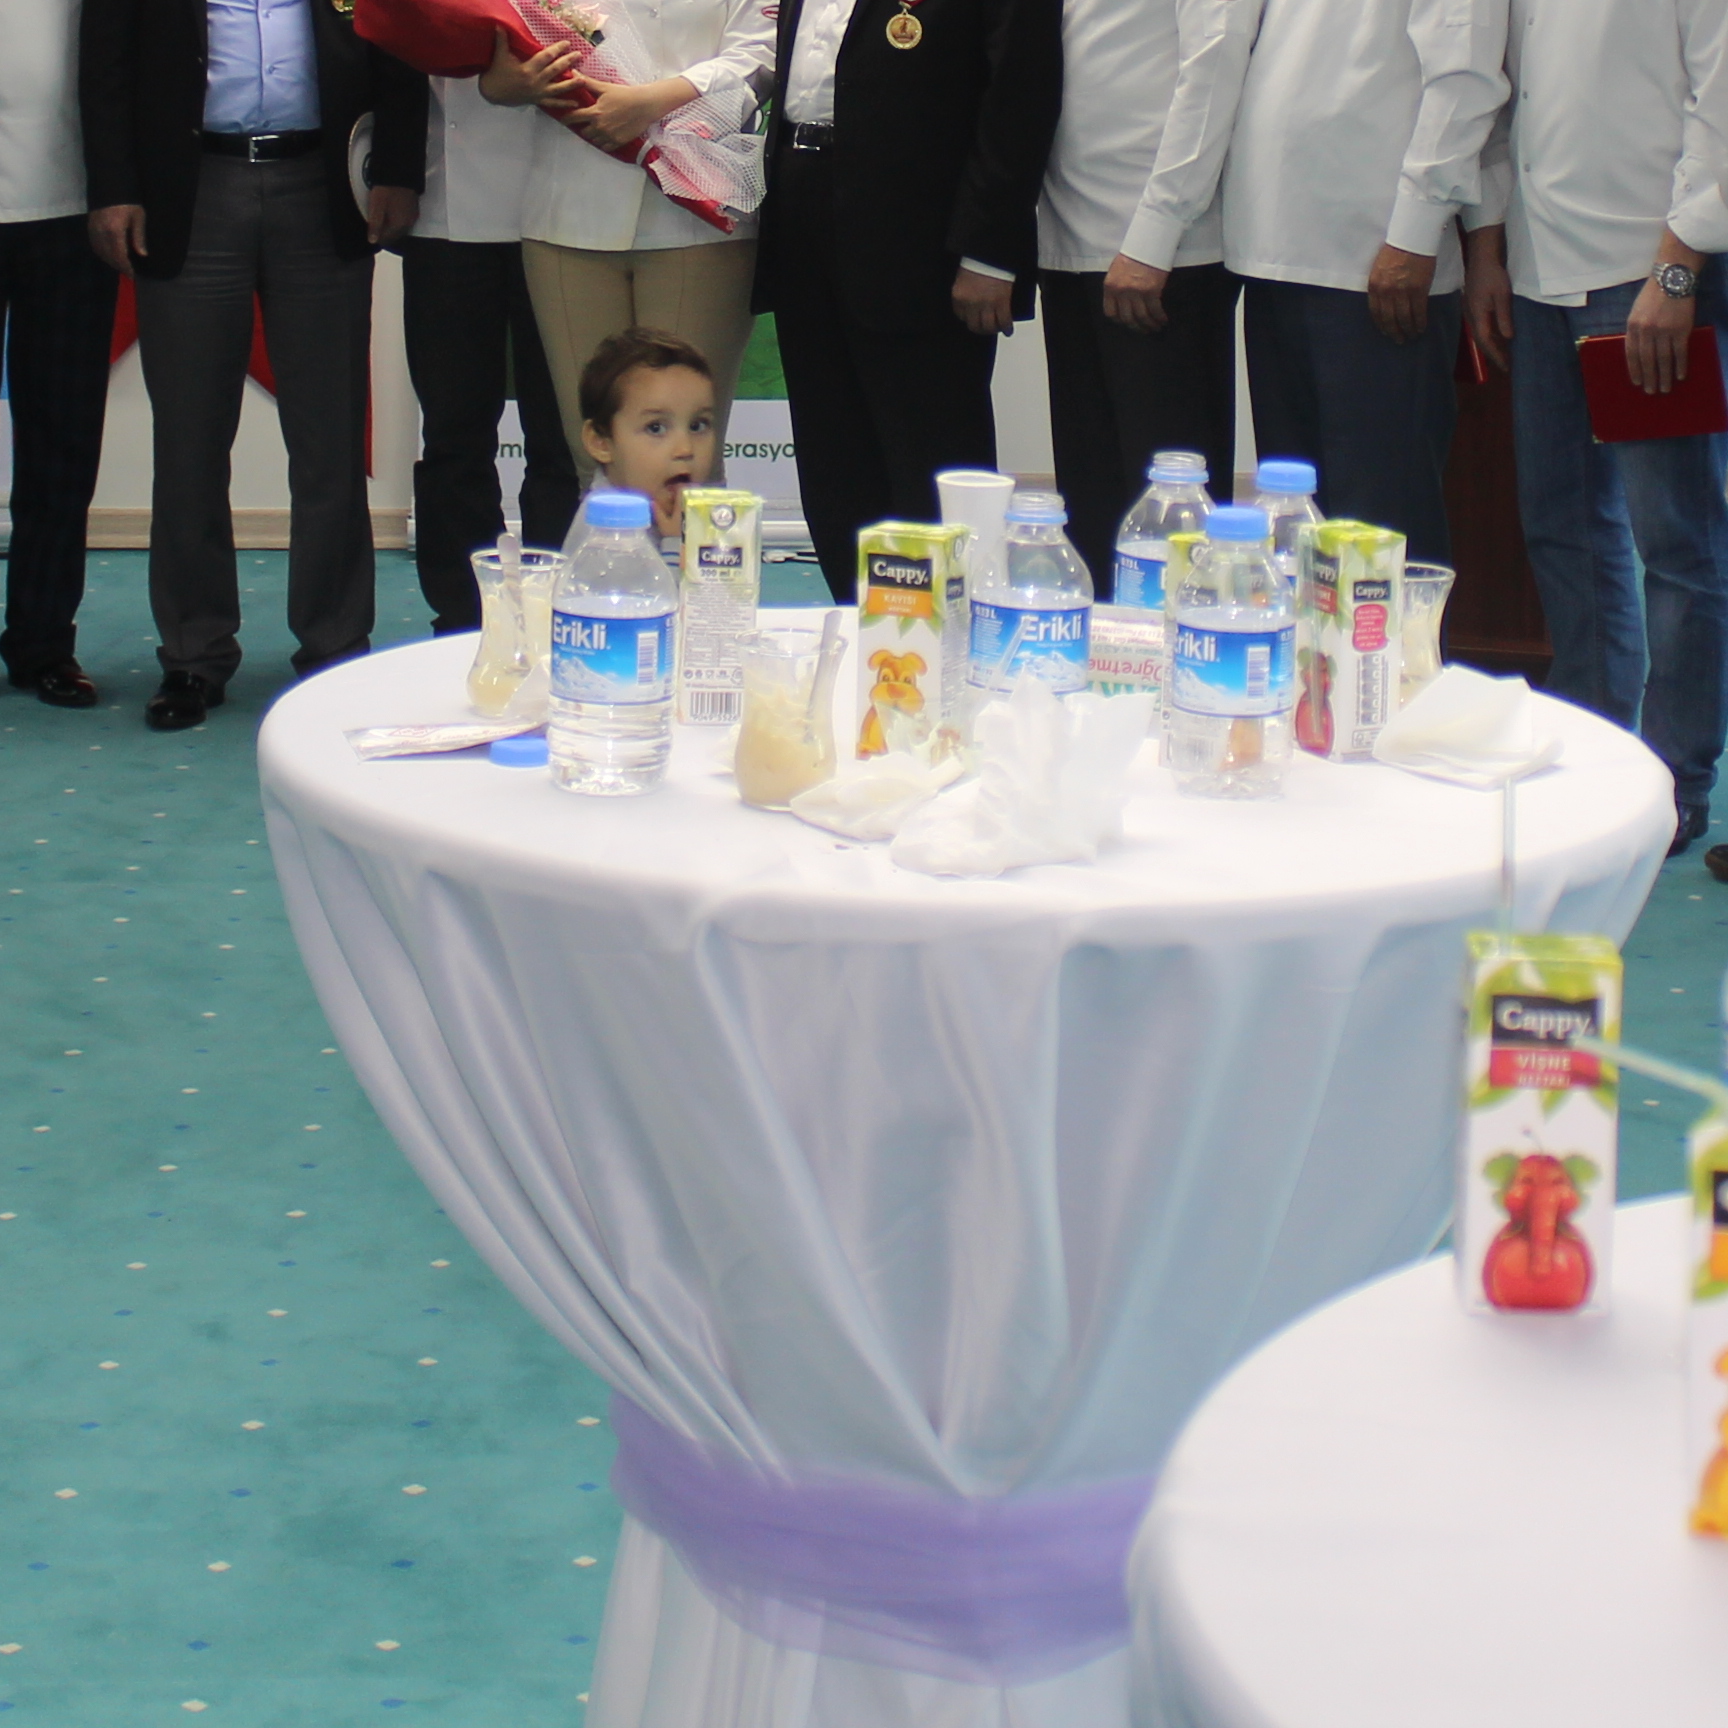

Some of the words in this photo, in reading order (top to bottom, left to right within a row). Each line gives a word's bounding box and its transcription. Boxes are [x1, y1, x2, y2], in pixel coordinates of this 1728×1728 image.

[702, 551, 738, 565] Cappy
[874, 561, 926, 585] Cappy
[1356, 585, 1387, 598] Cappy
[553, 615, 608, 650] Erikli
[1020, 613, 1083, 642] Erikli
[1176, 632, 1217, 663] rikli
[1496, 1001, 1591, 1040] Cappy
